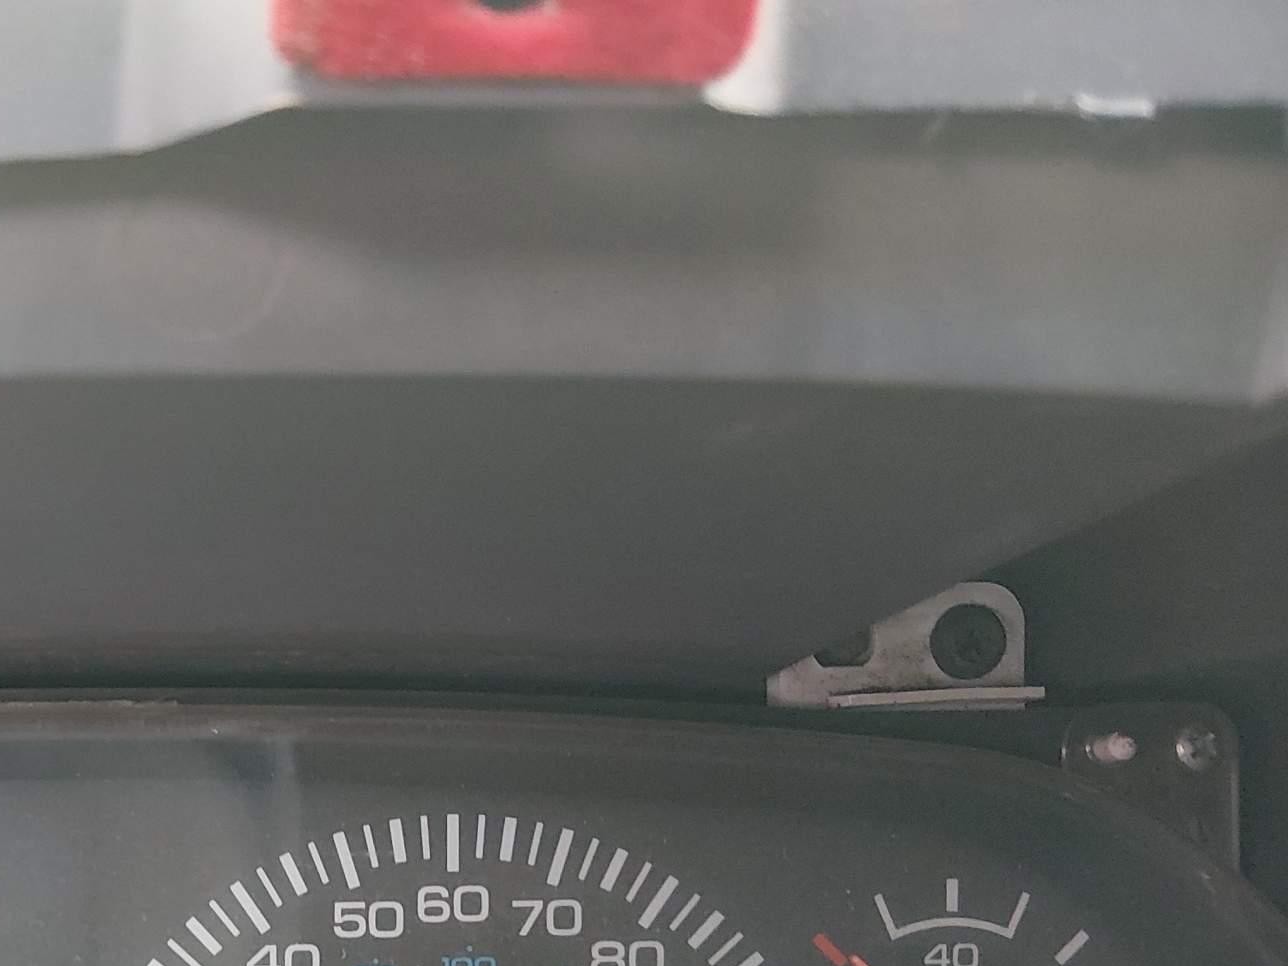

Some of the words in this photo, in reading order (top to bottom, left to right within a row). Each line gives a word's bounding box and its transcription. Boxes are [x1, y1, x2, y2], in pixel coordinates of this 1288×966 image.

[334, 902, 404, 938] 50
[417, 886, 489, 923] 60
[512, 899, 582, 936] 70
